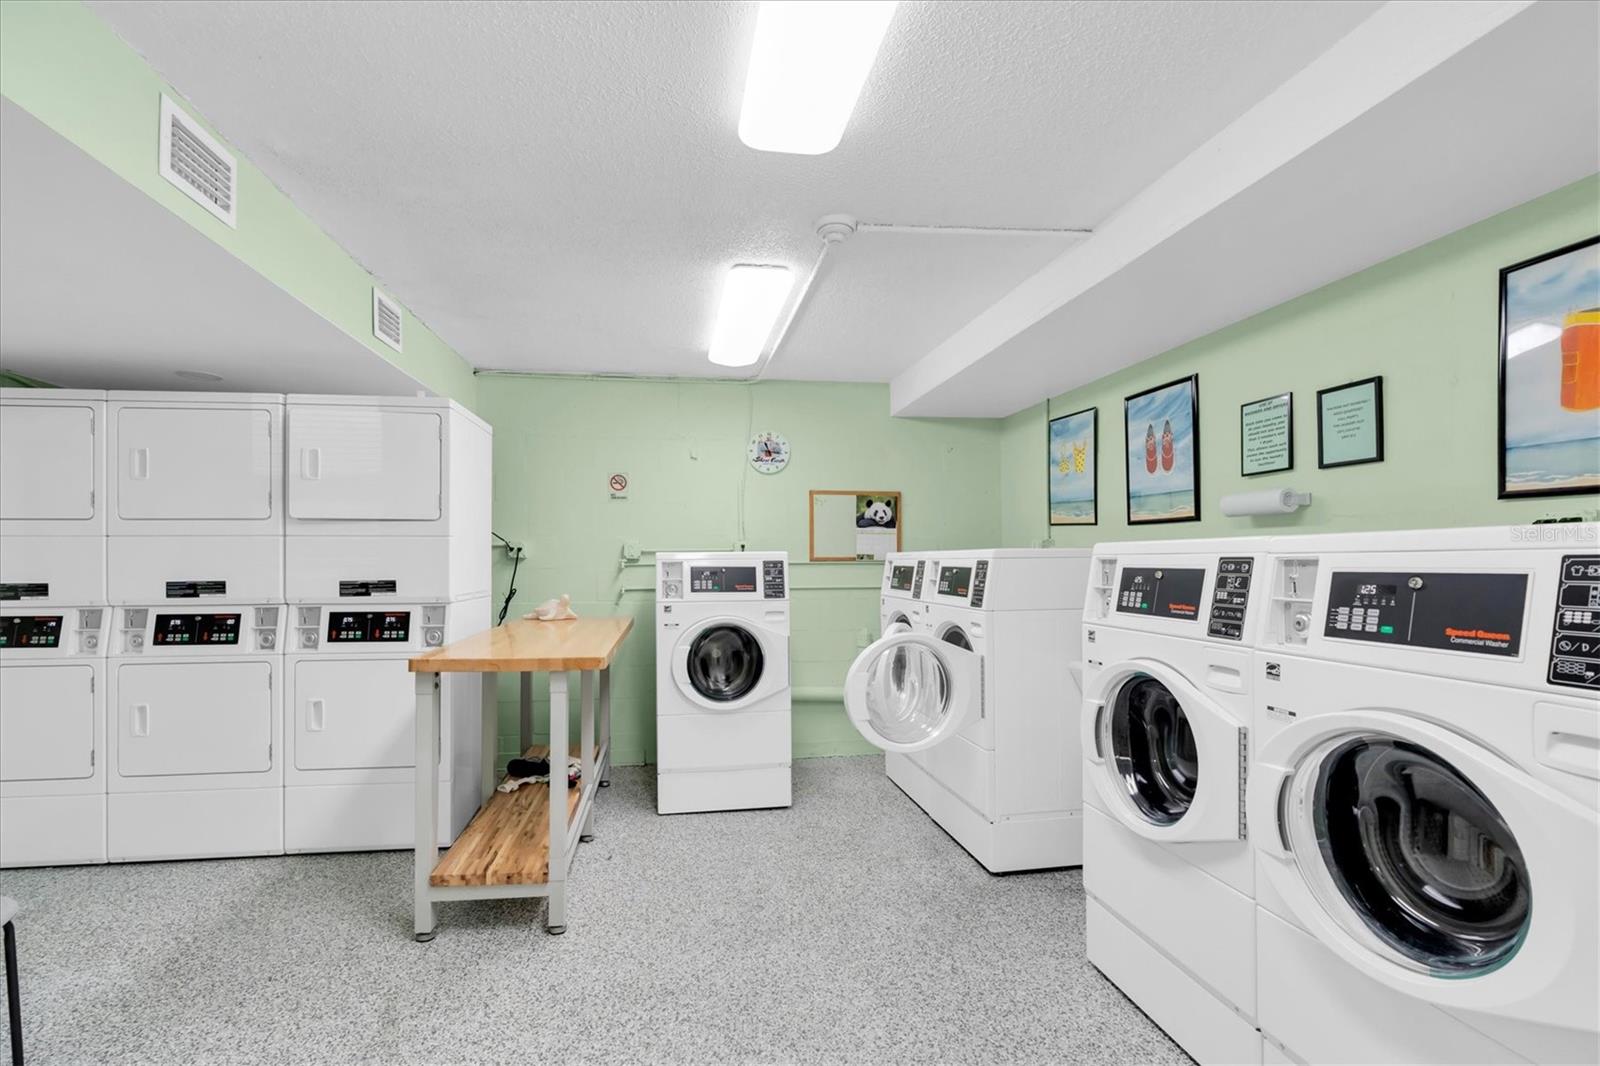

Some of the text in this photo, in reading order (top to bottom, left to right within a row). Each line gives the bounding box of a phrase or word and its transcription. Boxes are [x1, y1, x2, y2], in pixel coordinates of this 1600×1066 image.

[1445, 627, 1511, 641] Speed Queen
[1450, 636, 1510, 648] Commercial Washer
